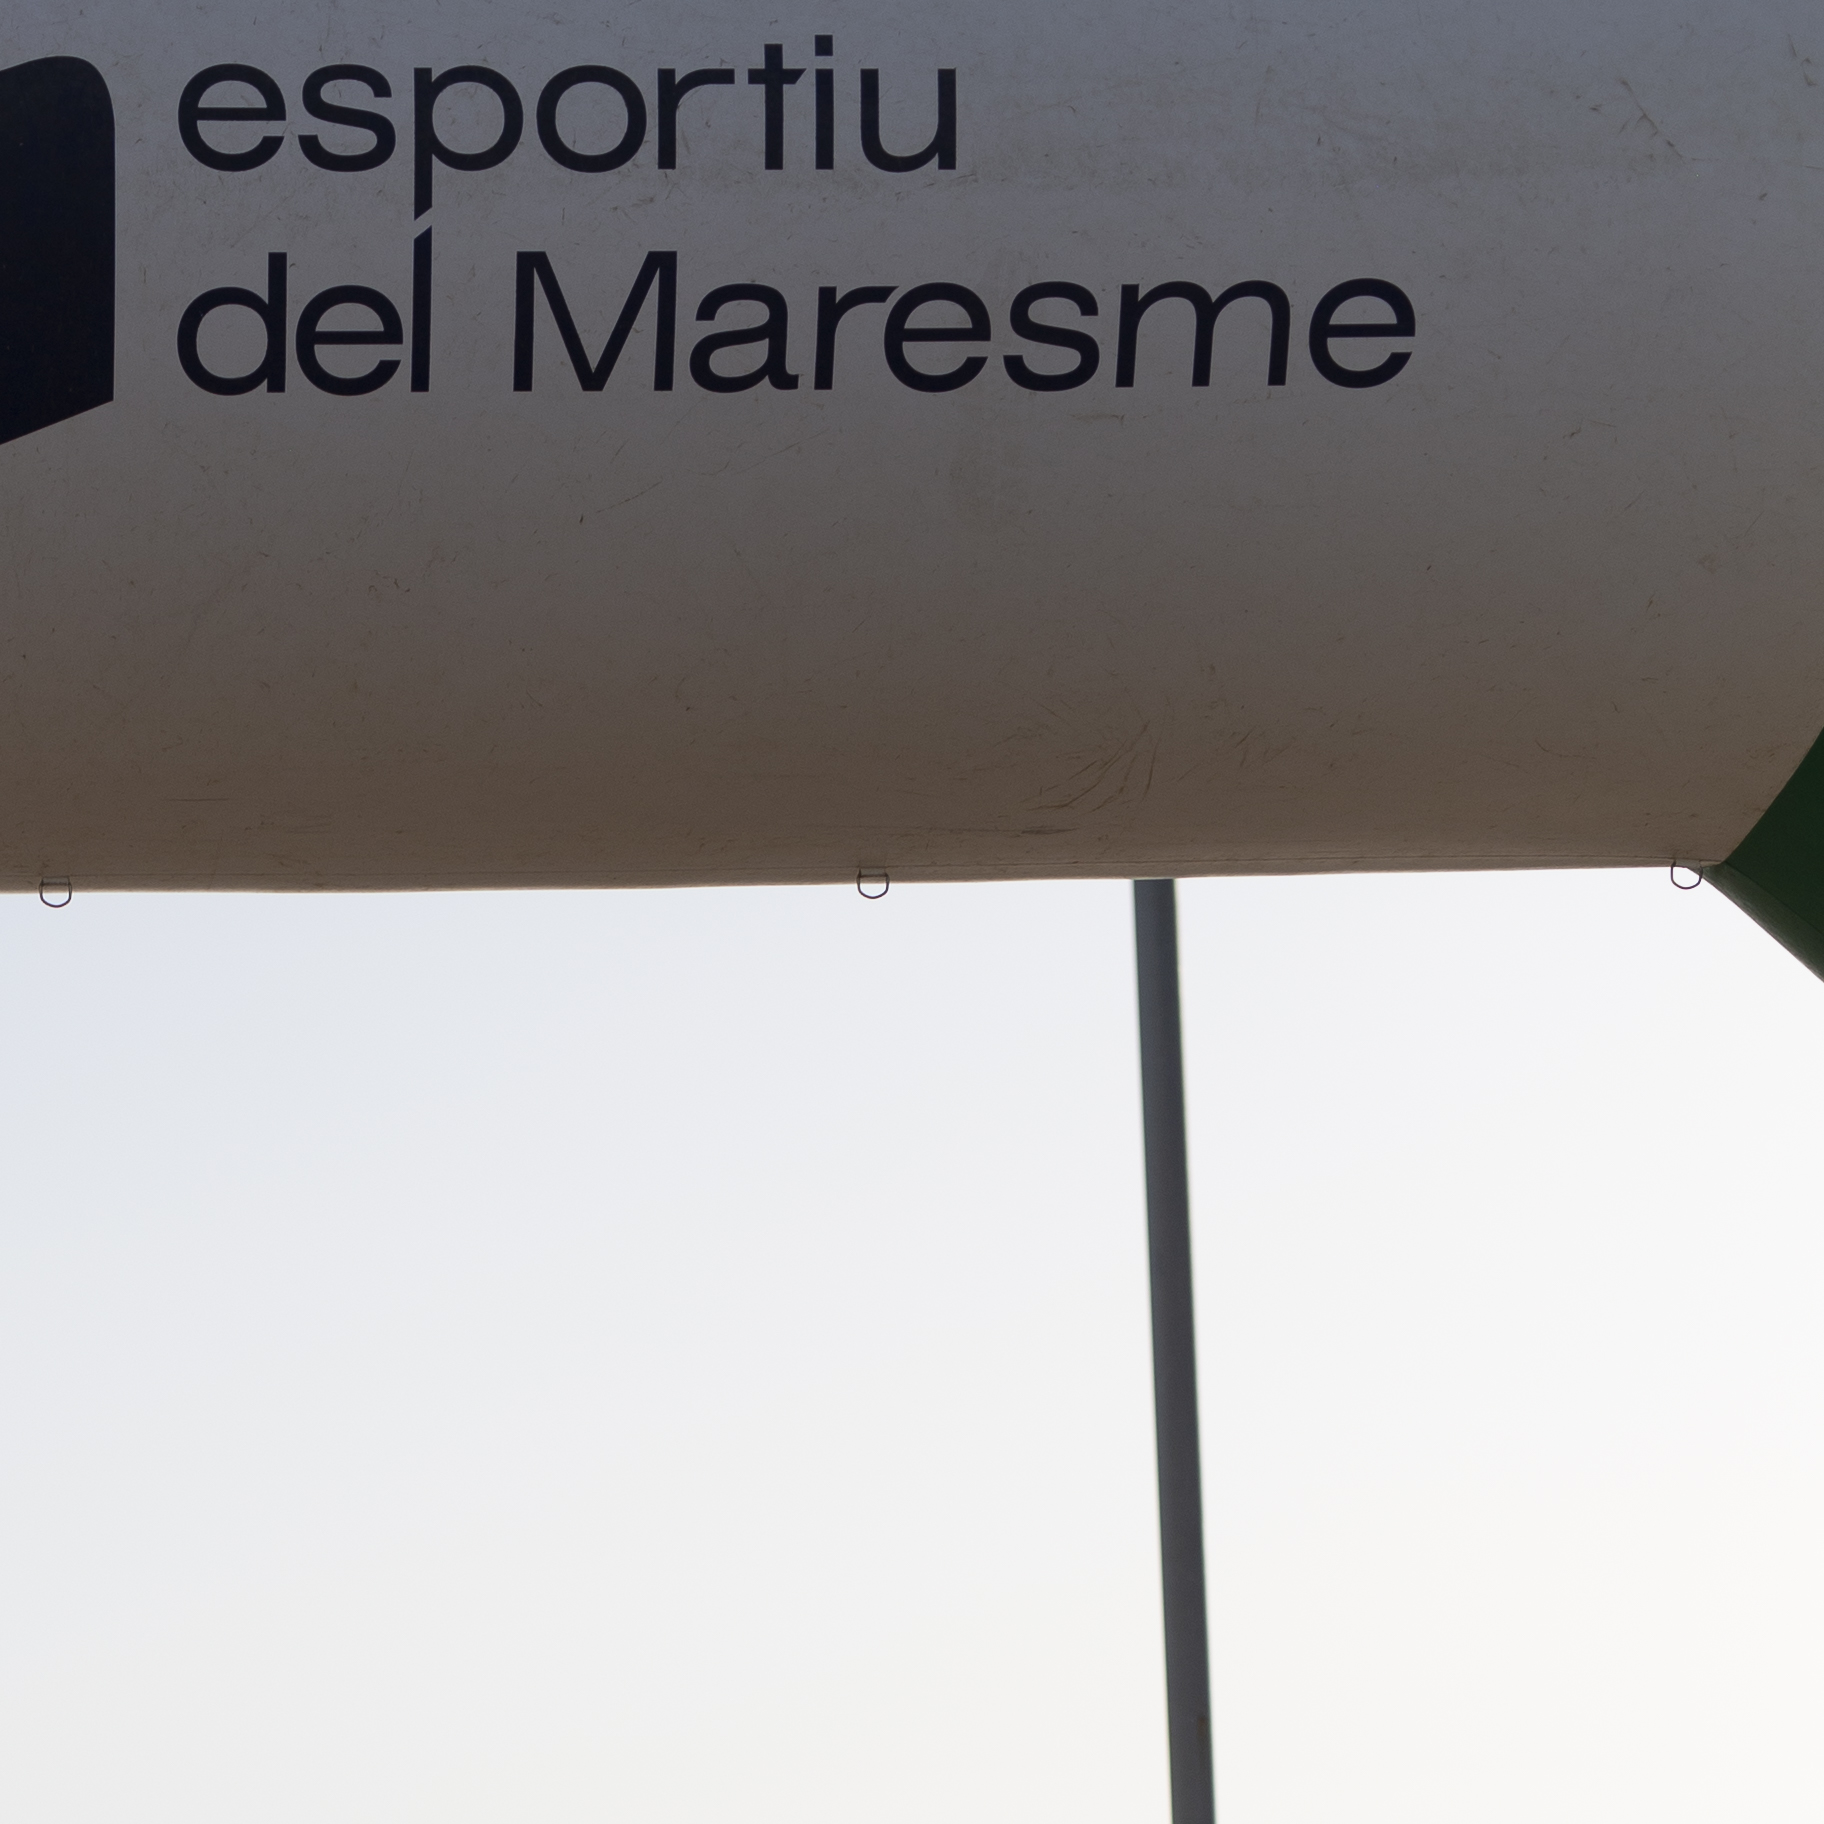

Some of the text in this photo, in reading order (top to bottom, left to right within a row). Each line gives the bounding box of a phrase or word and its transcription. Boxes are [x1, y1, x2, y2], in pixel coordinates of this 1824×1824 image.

[177, 35, 958, 222] esportiu
[177, 225, 1416, 397] del Maresme
